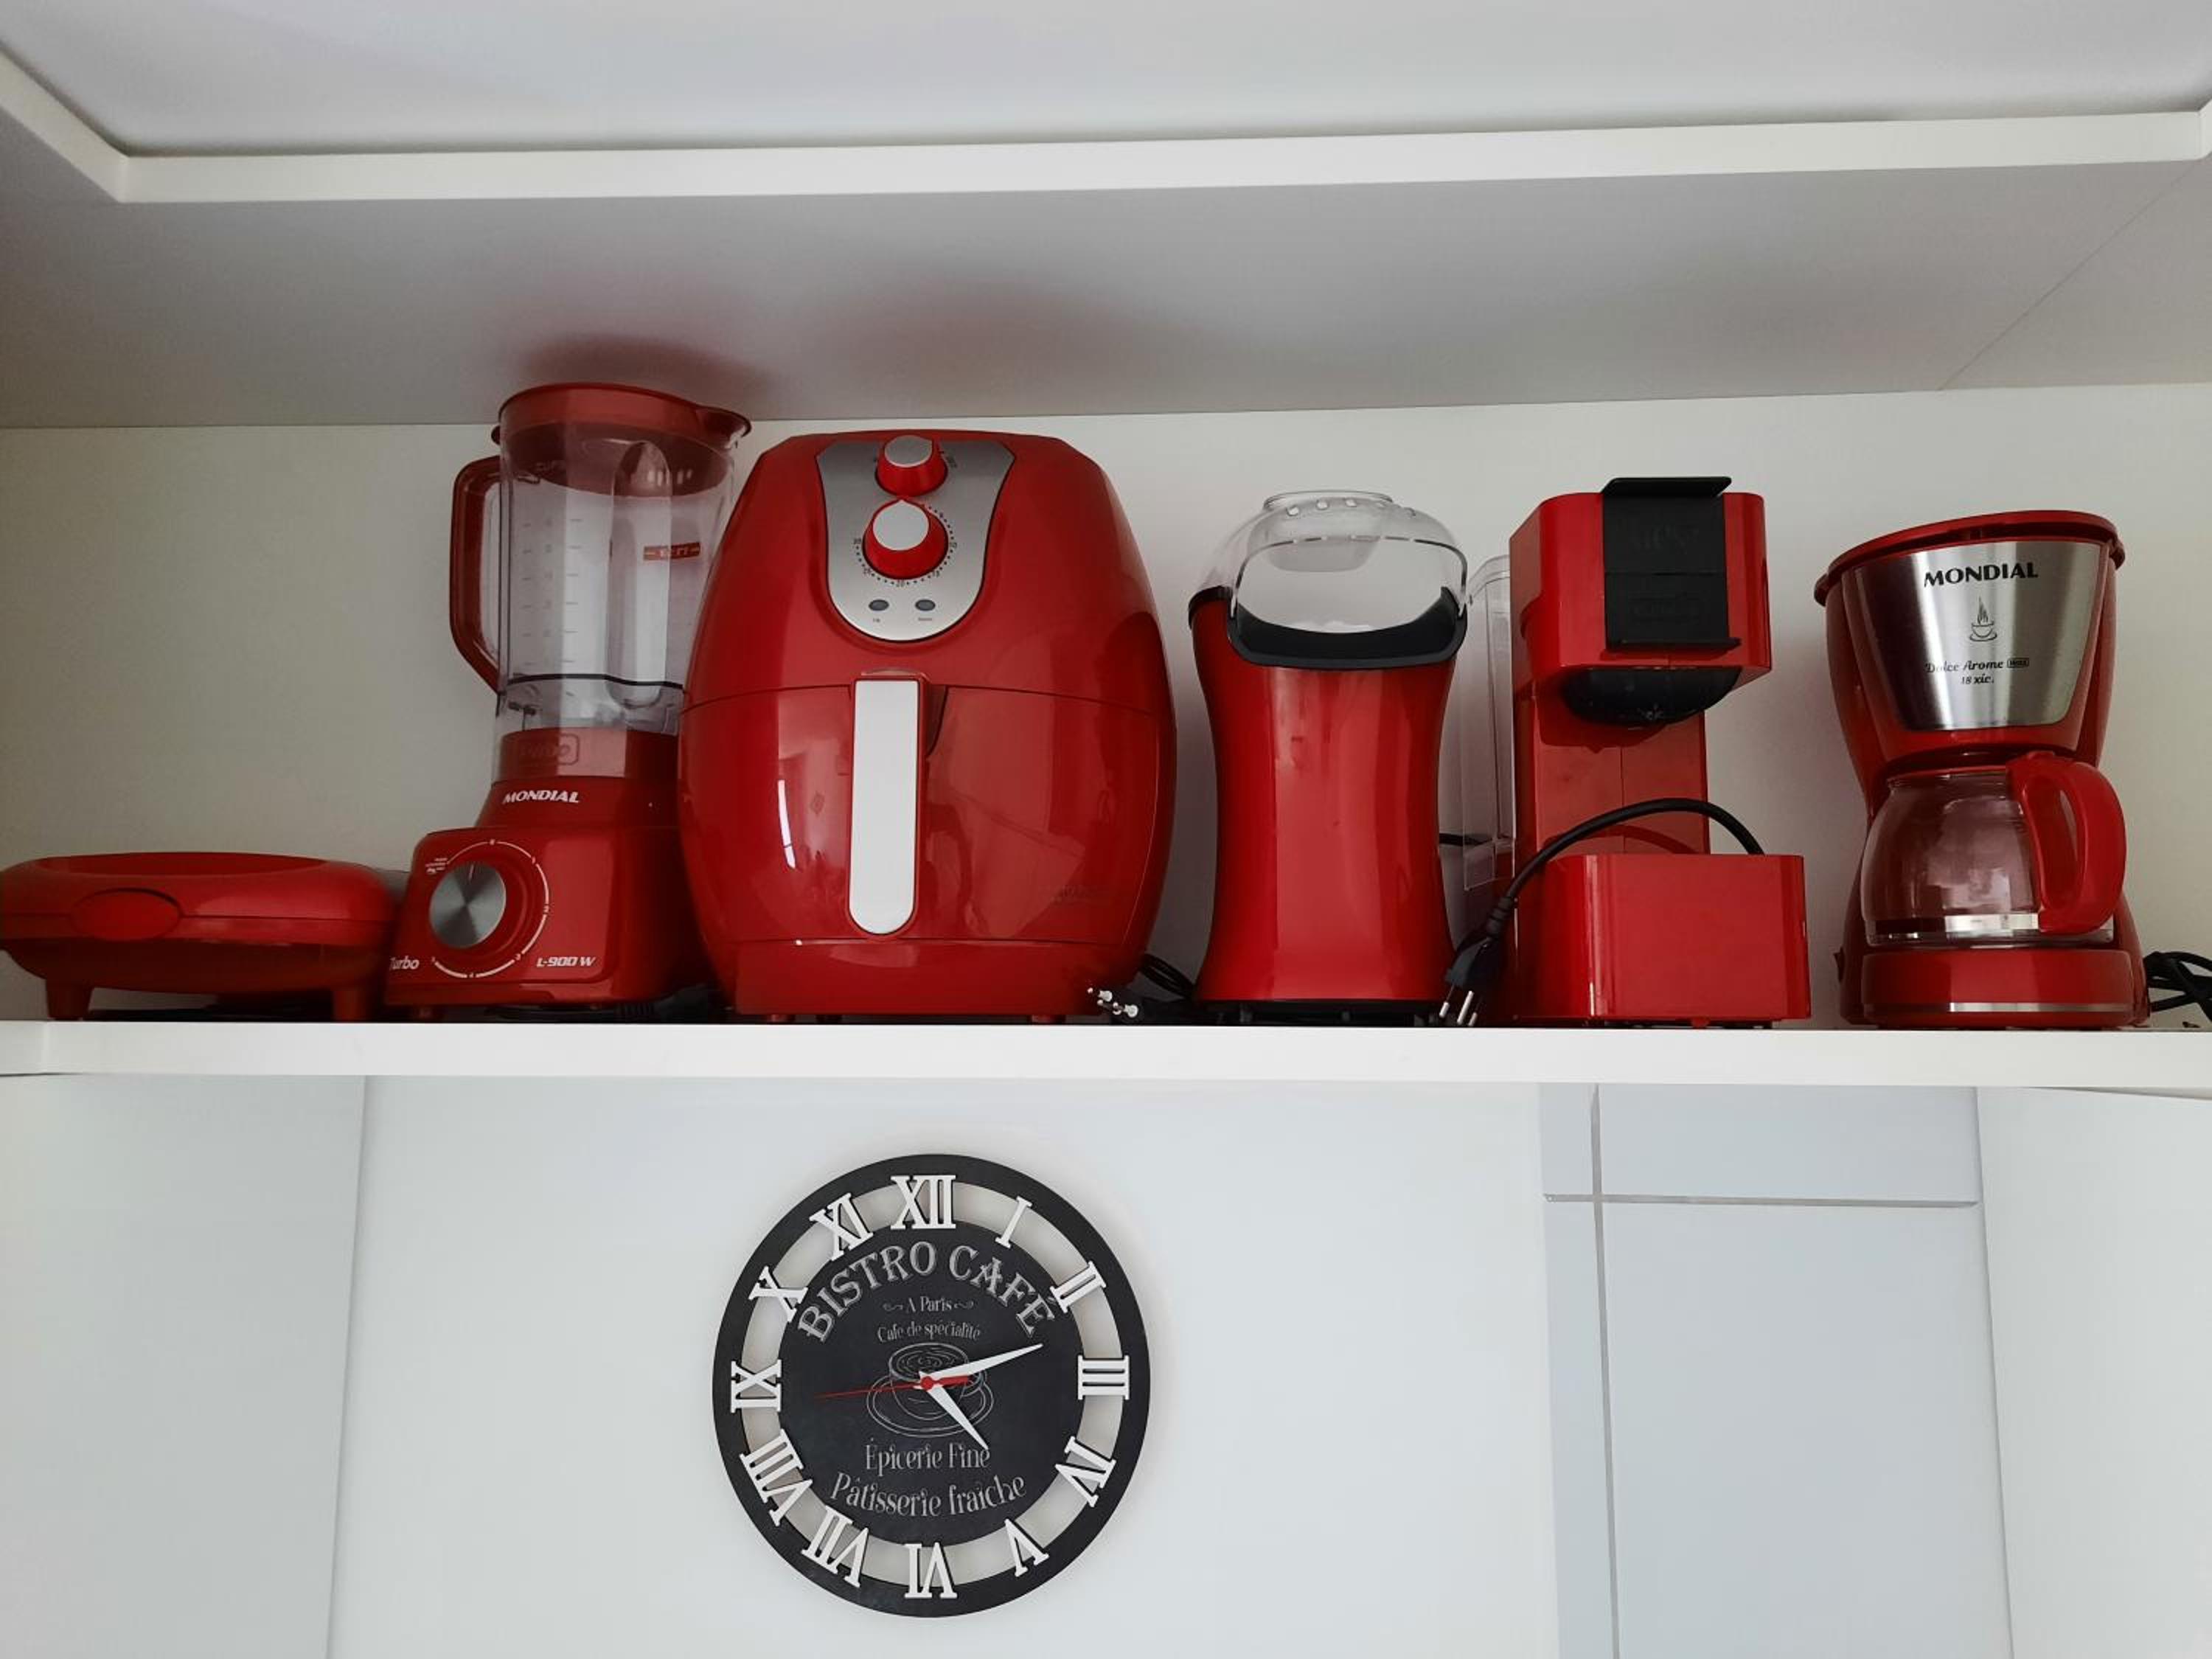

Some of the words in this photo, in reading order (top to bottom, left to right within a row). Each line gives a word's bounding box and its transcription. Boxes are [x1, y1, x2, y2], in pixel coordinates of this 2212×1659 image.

[1924, 562, 2039, 588] MONDIAL
[1963, 659, 2003, 671] Arome
[502, 790, 580, 804] MONDIAL
[389, 955, 420, 970] Turbo
[809, 1192, 874, 1262] XI
[890, 1175, 956, 1230] XII
[995, 1195, 1032, 1248] I
[748, 1266, 809, 1323] X
[799, 1241, 937, 1343] BISTRO
[920, 1295, 953, 1312] Paris
[1049, 1261, 1106, 1313] II
[907, 1320, 922, 1338] de
[731, 1360, 782, 1413] IX
[1077, 1354, 1130, 1400] III
[740, 1428, 813, 1527] VIII
[948, 1441, 990, 1469] Fine
[1054, 1436, 1116, 1507] IV
[830, 1472, 942, 1517] Pâtisserie
[801, 1505, 869, 1587] VII
[904, 1542, 958, 1599] VI
[1004, 1518, 1049, 1577] V
